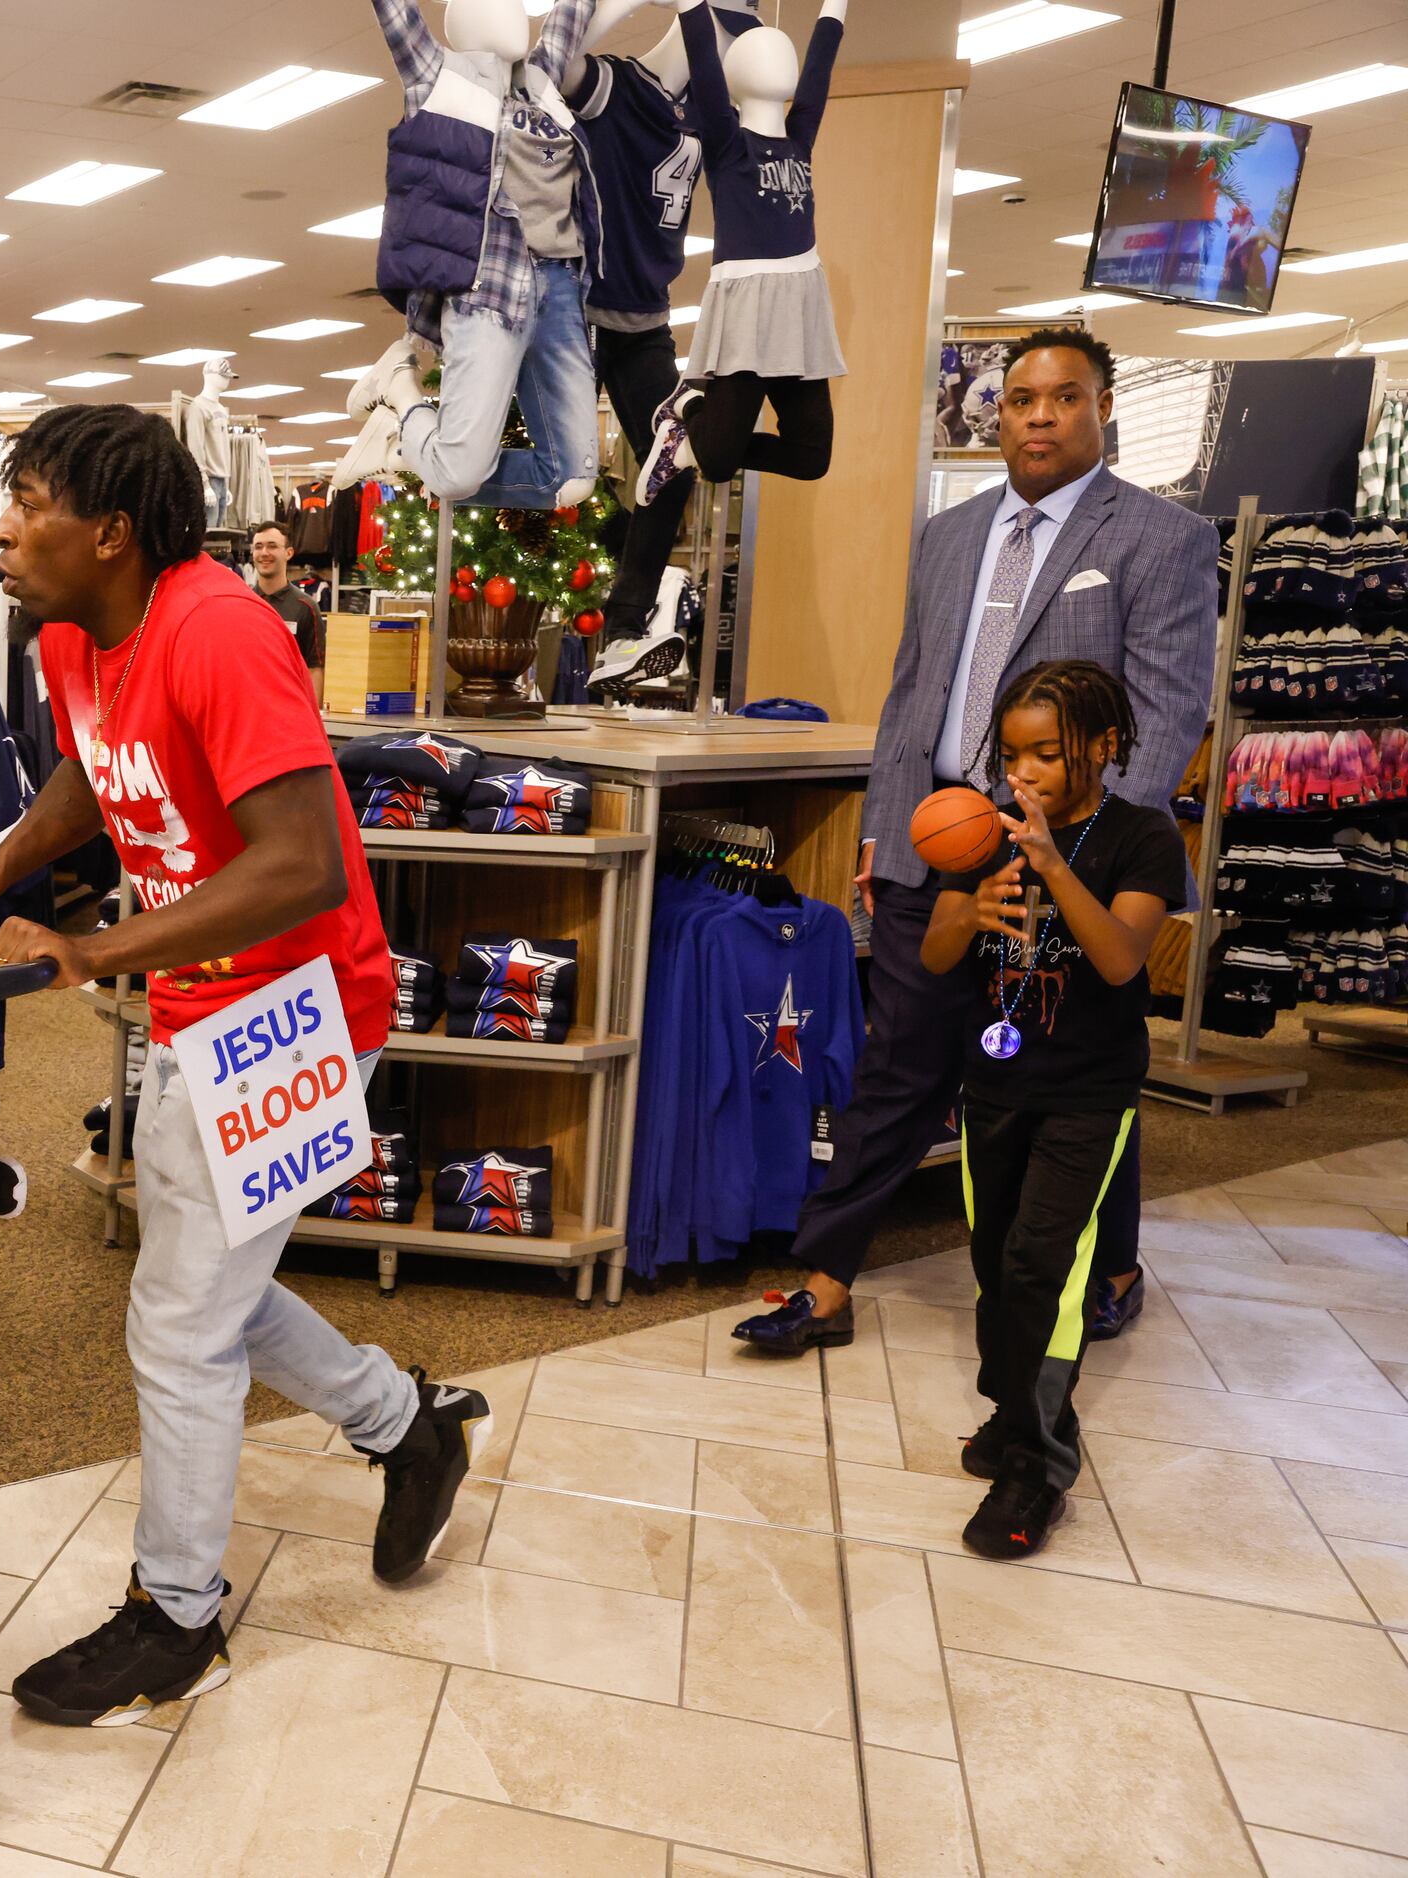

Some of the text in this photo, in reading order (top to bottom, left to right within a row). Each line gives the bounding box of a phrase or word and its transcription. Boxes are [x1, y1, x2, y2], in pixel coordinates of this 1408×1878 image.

[652, 133, 702, 230] 4
[1046, 936, 1084, 963] Saves
[212, 988, 322, 1086] JESUS
[216, 1054, 348, 1157] BLOOD
[242, 1119, 354, 1215] SAVES
